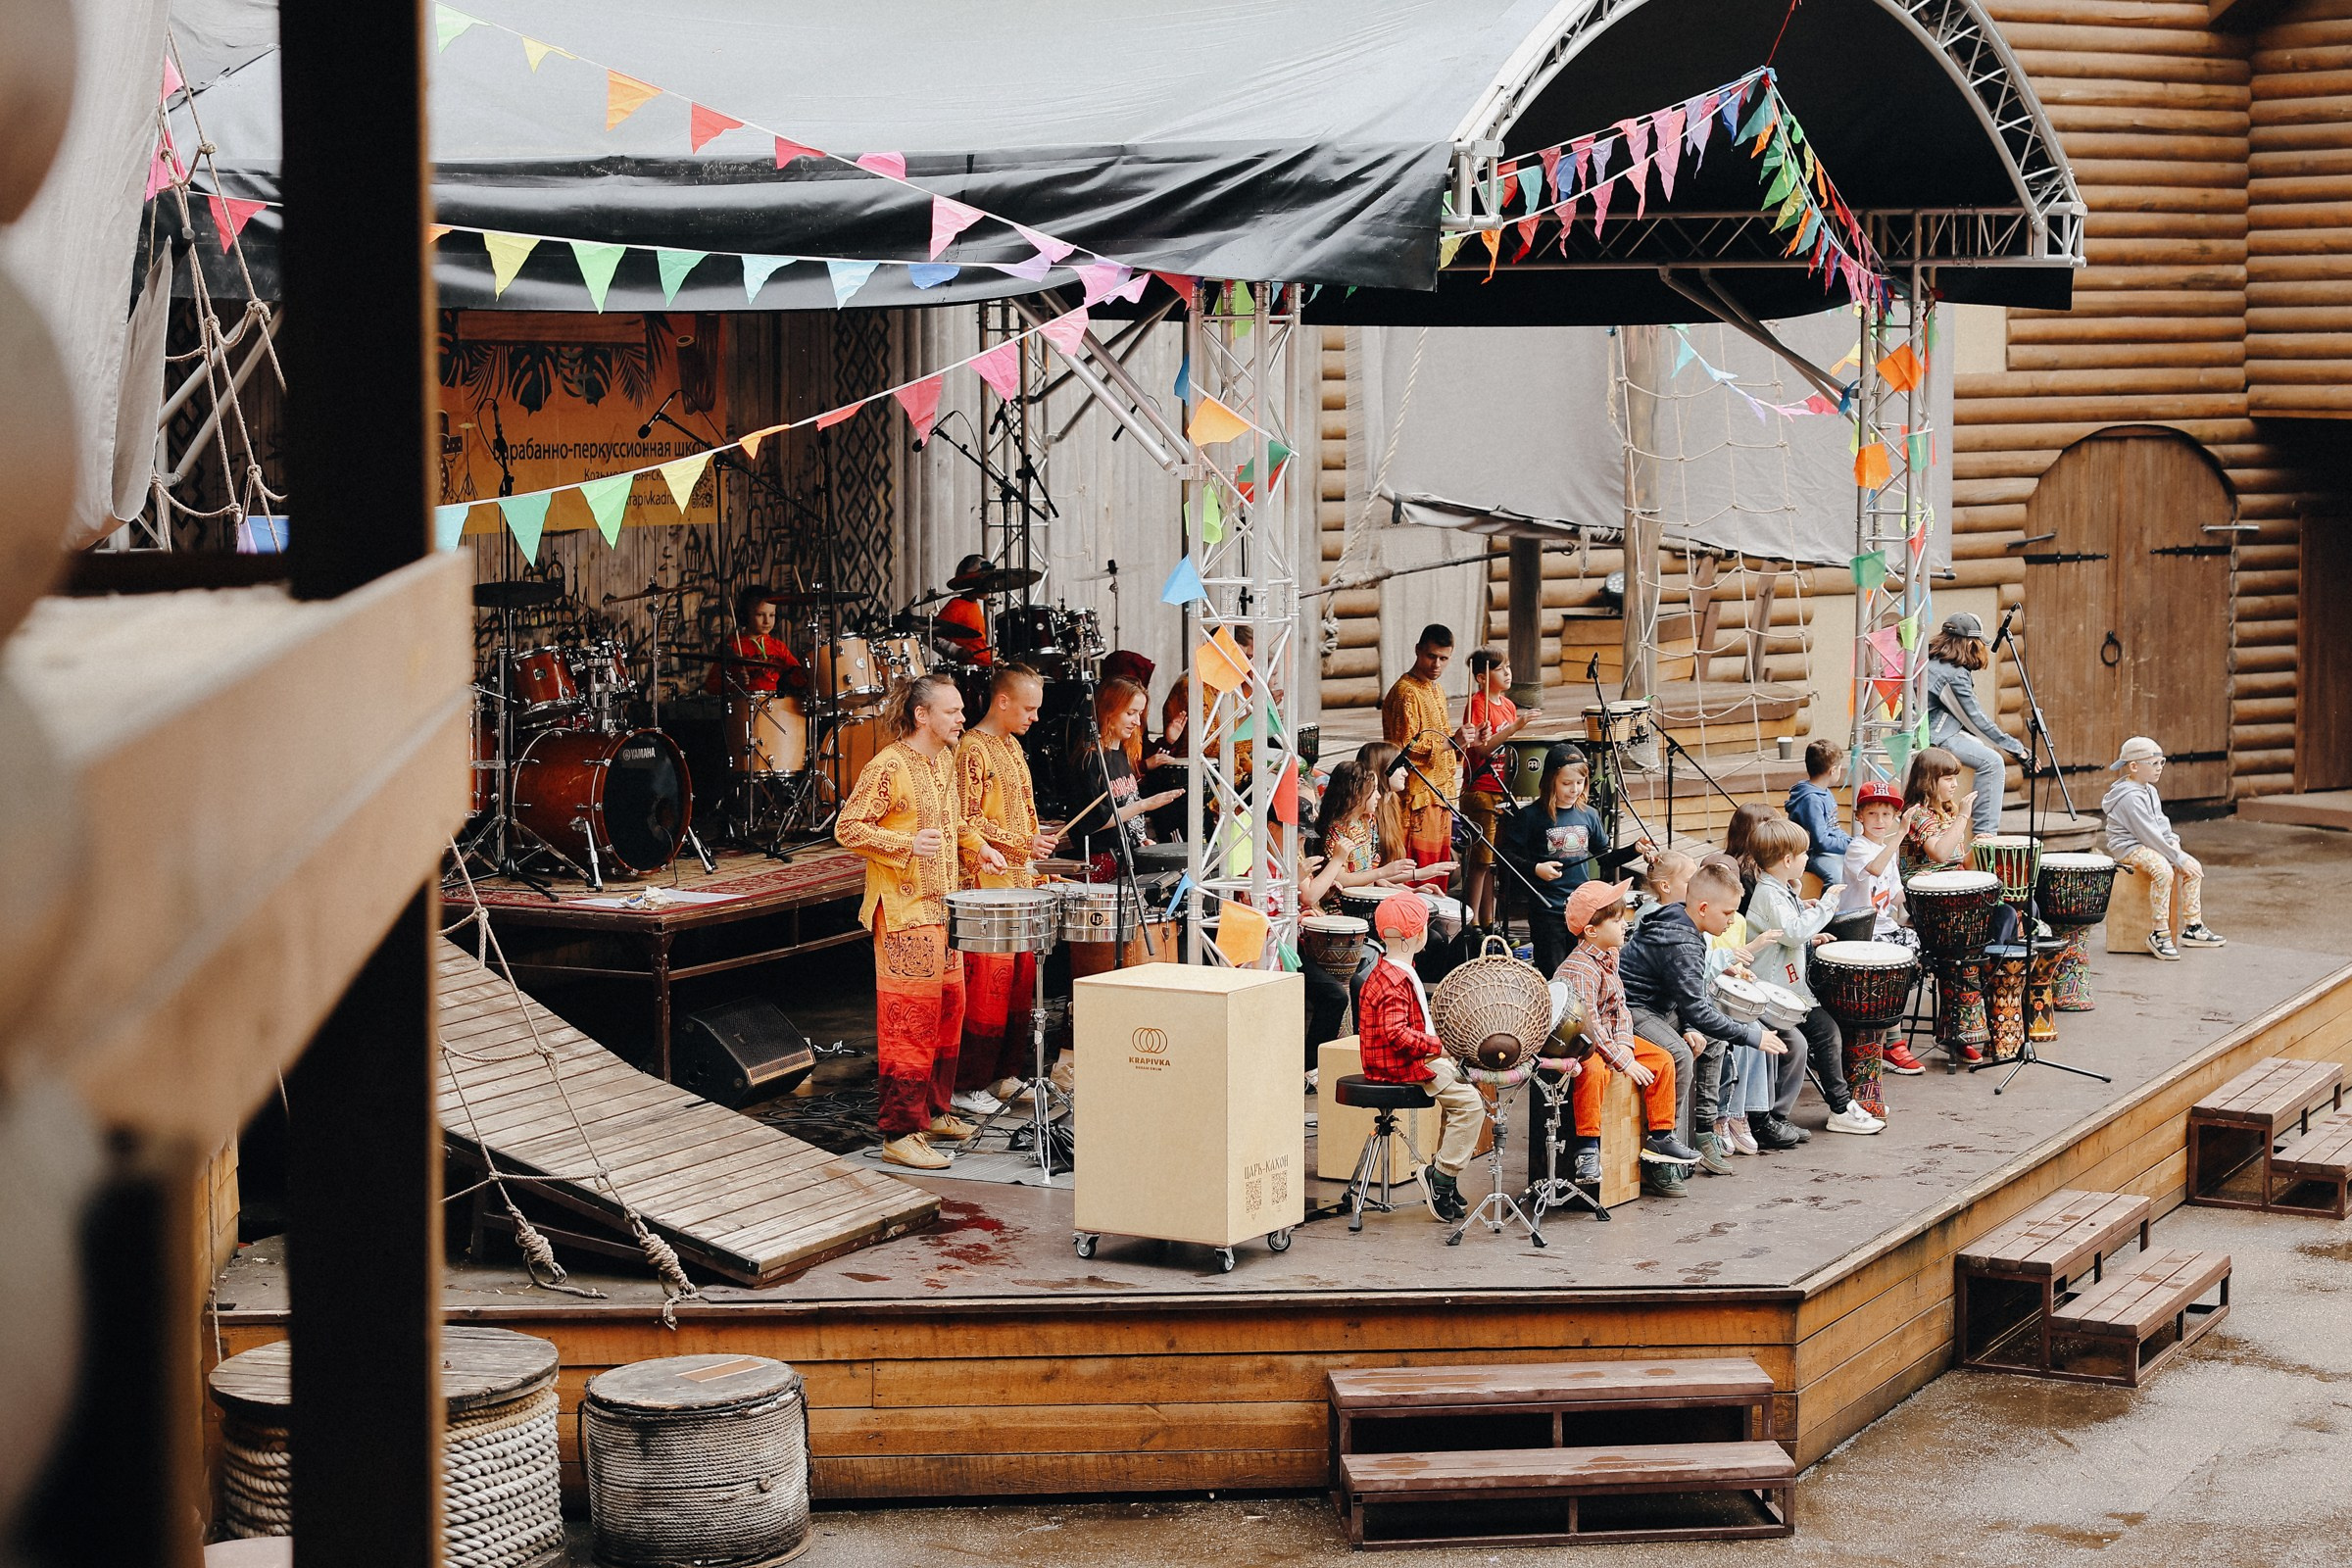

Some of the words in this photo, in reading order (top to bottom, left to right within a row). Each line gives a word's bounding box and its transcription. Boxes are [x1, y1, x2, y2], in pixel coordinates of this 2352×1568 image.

[493, 438, 670, 465] рабанно-перкуссионная
[673, 441, 712, 458] шко
[627, 490, 675, 510] rapivkadru
[631, 747, 656, 760] YAMAHA
[1874, 782, 1889, 796] H
[1129, 1056, 1171, 1066] KRAPIVKA
